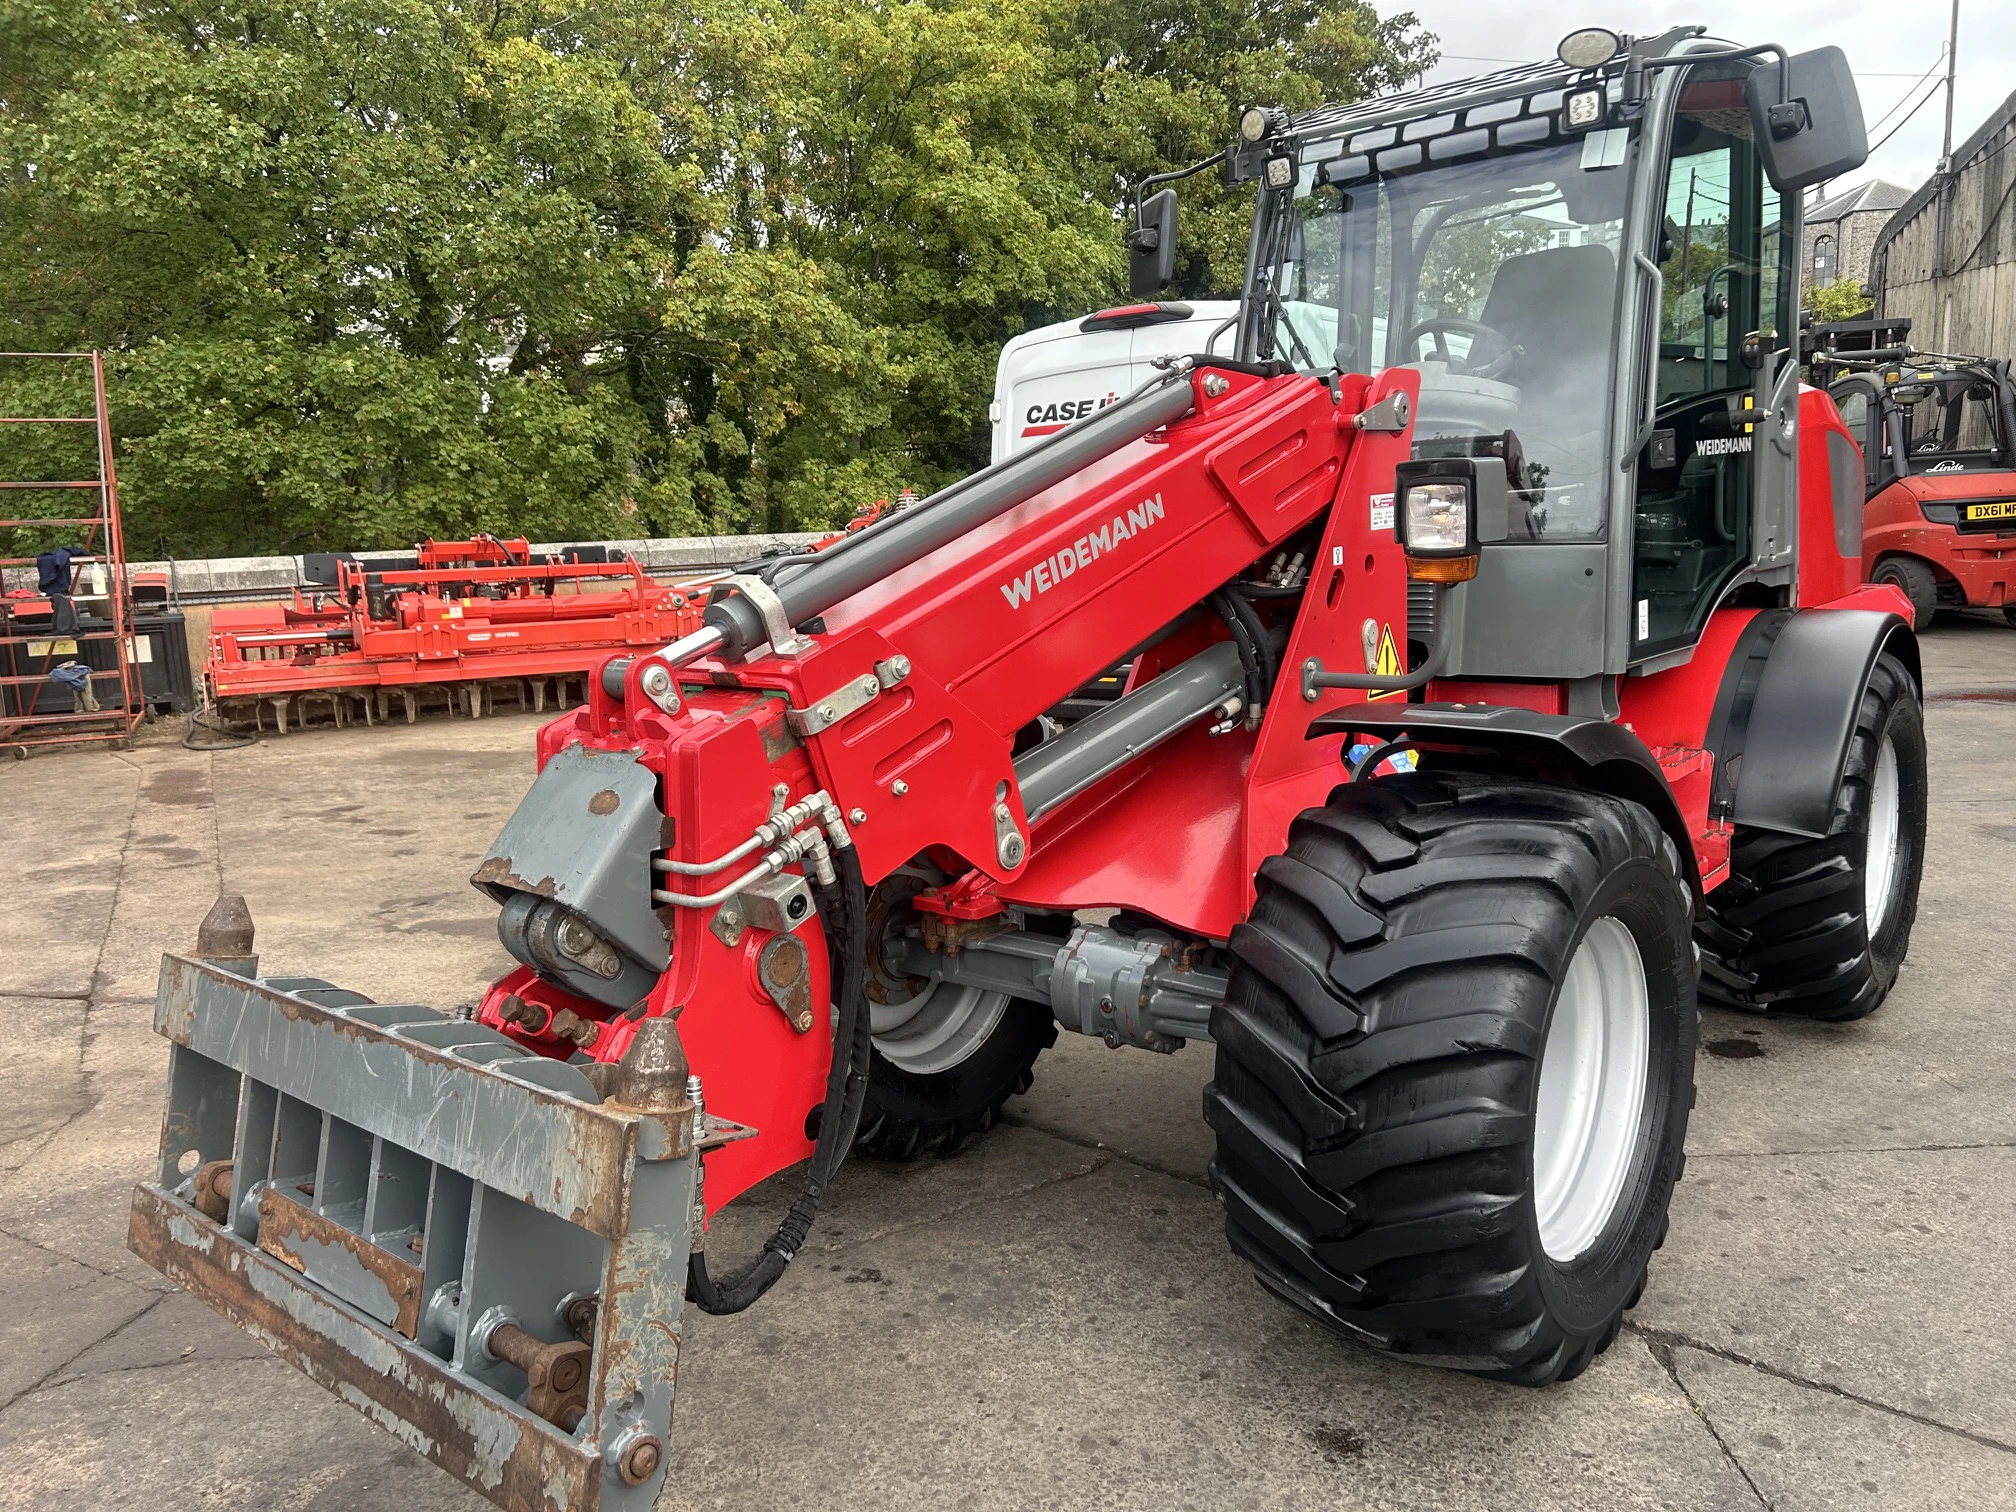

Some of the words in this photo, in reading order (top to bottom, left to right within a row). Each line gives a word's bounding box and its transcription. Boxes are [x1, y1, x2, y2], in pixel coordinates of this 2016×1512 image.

[1026, 399, 1094, 424] CASE
[1695, 436, 1752, 456] WEIDEMANN
[1925, 460, 1964, 473] Linde
[1975, 505, 2002, 517] DX61
[1000, 491, 1165, 610] WEIDEMANN
